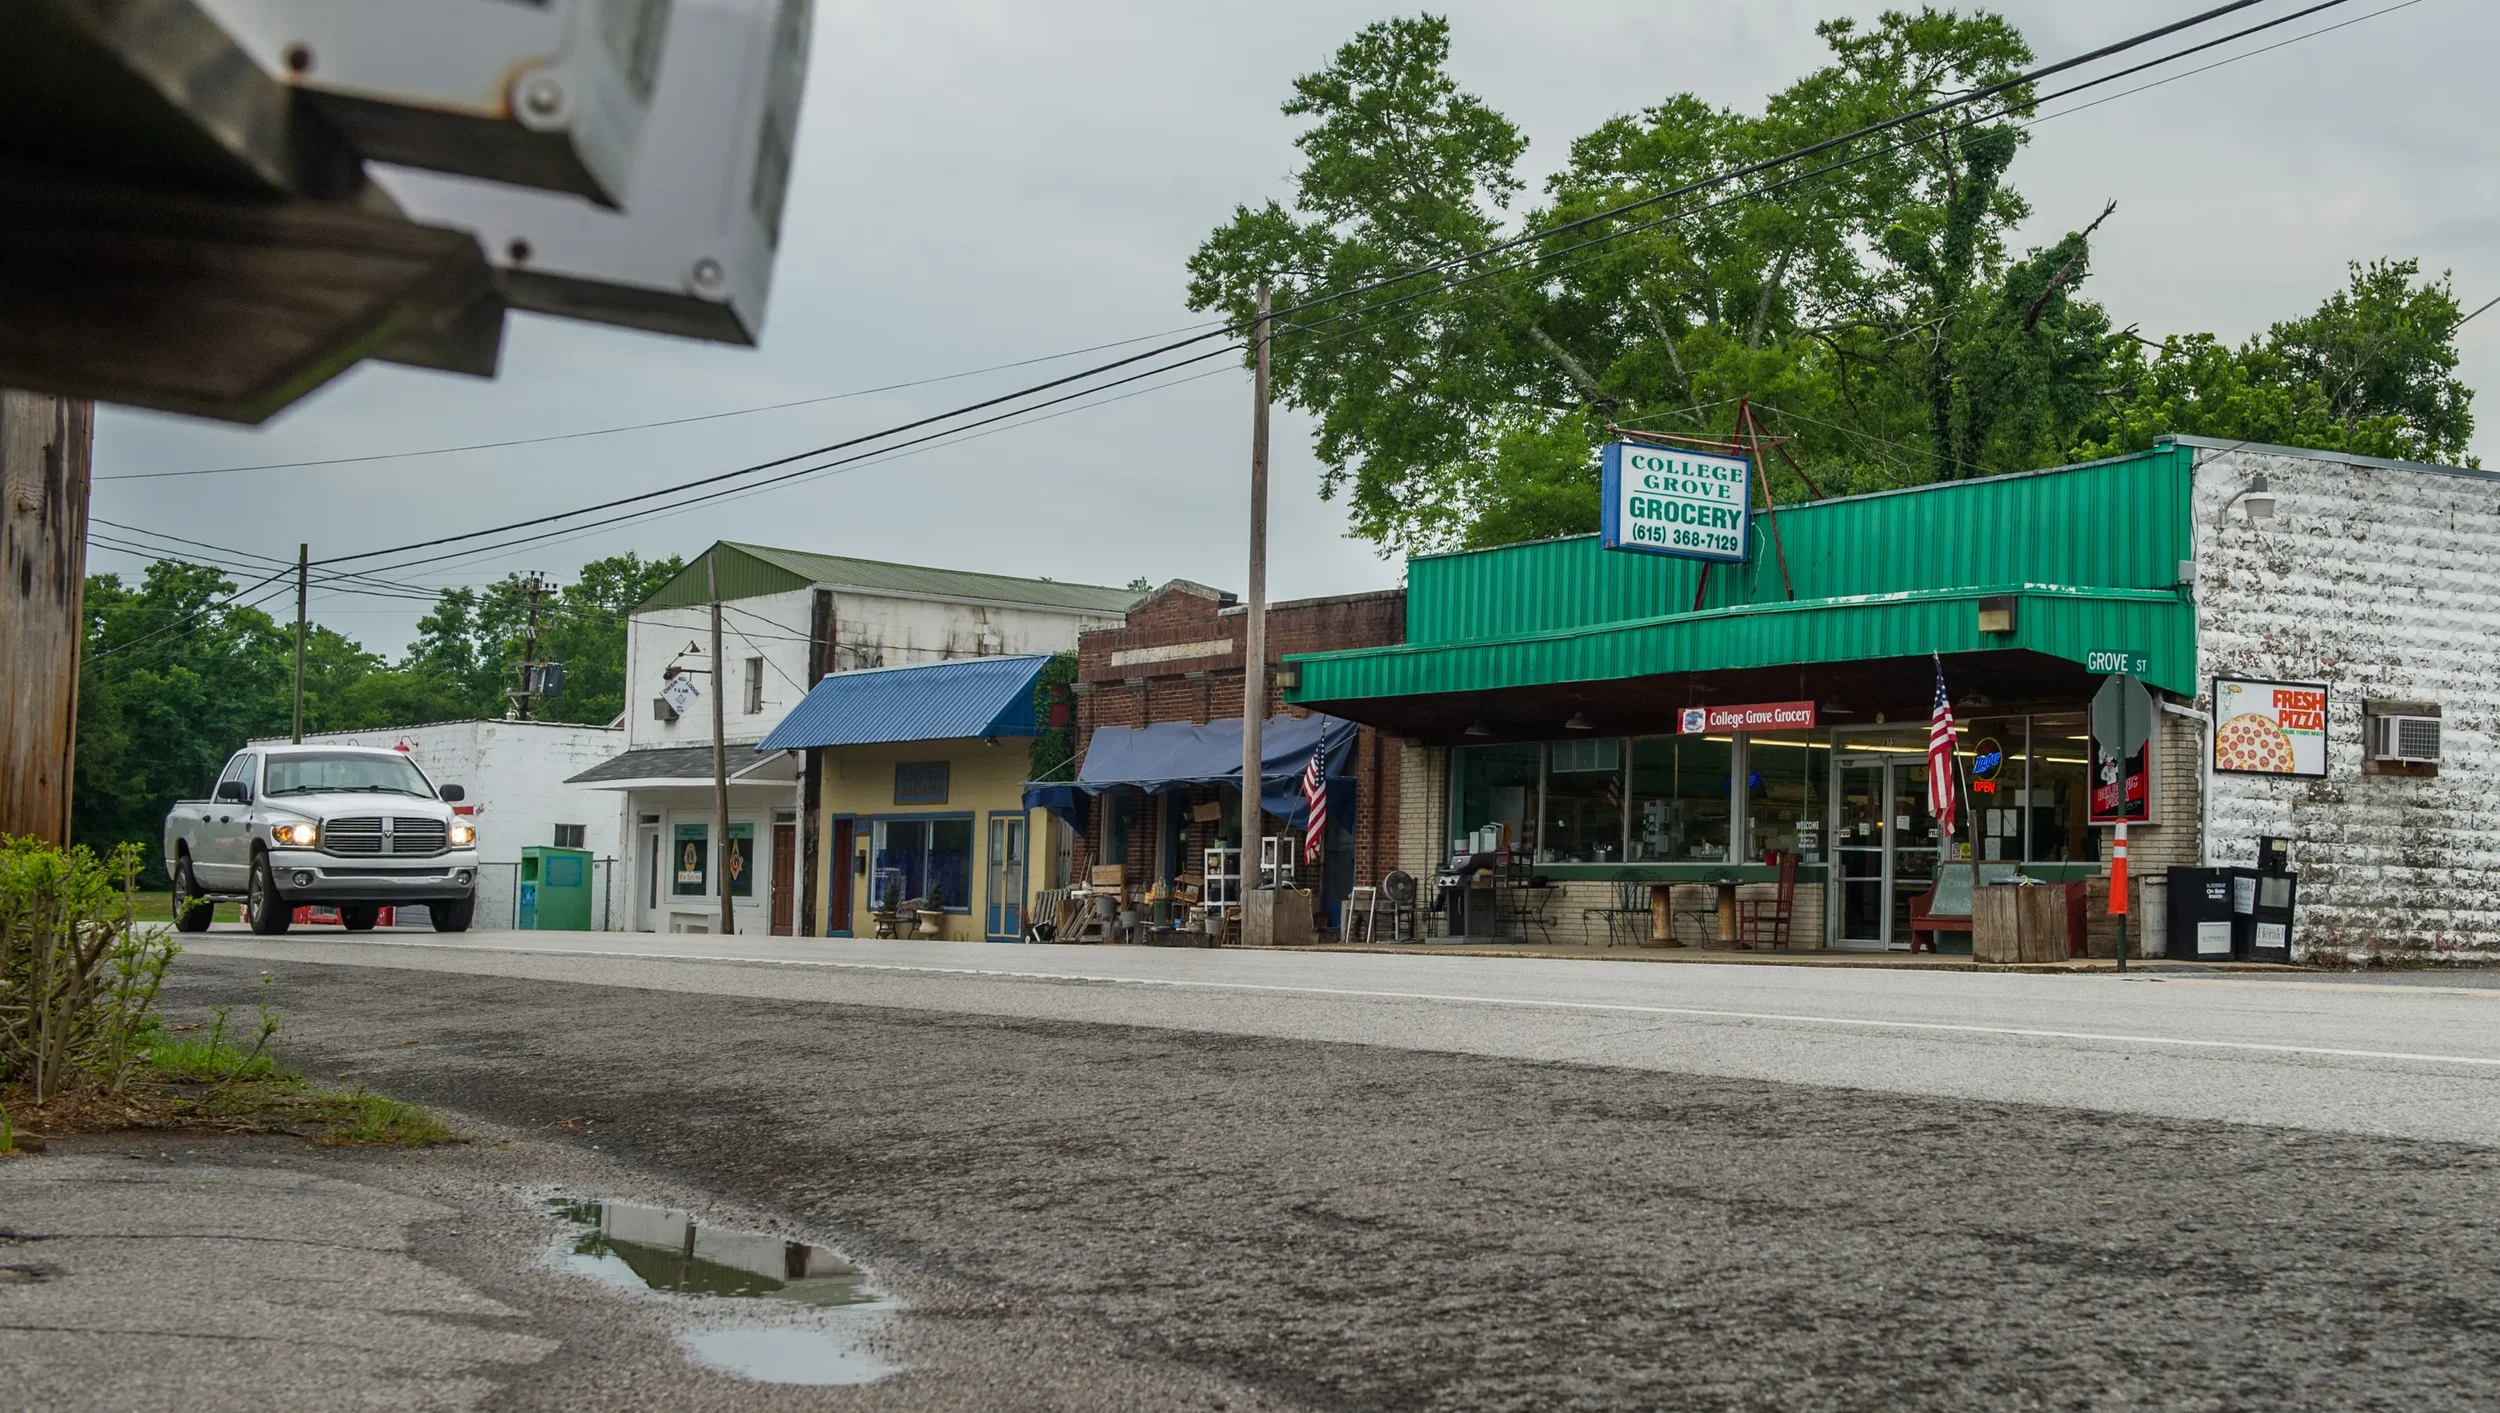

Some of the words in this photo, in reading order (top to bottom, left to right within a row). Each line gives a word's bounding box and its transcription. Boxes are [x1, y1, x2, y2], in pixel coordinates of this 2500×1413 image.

[1631, 455, 1743, 483] COLLEGE
[1643, 474, 1731, 499] GROVE
[1629, 496, 1742, 530] GROCERY
[1632, 523, 1667, 544] (615)
[1673, 529, 1738, 551] 368-7129
[2088, 651, 2129, 671] GROVE
[2136, 659, 2147, 672] ST
[663, 680, 678, 694] OWEN
[686, 681, 701, 697] LODGE
[2273, 690, 2324, 711] FRESH
[1710, 711, 1743, 728] College
[1746, 710, 1772, 724] Grove
[1774, 708, 1811, 725] Grocery
[2278, 709, 2324, 730] PIZZA
[1974, 781, 1995, 793] OPEN
[1796, 821, 1819, 830] WELCOME
[2257, 926, 2285, 940] Herald
